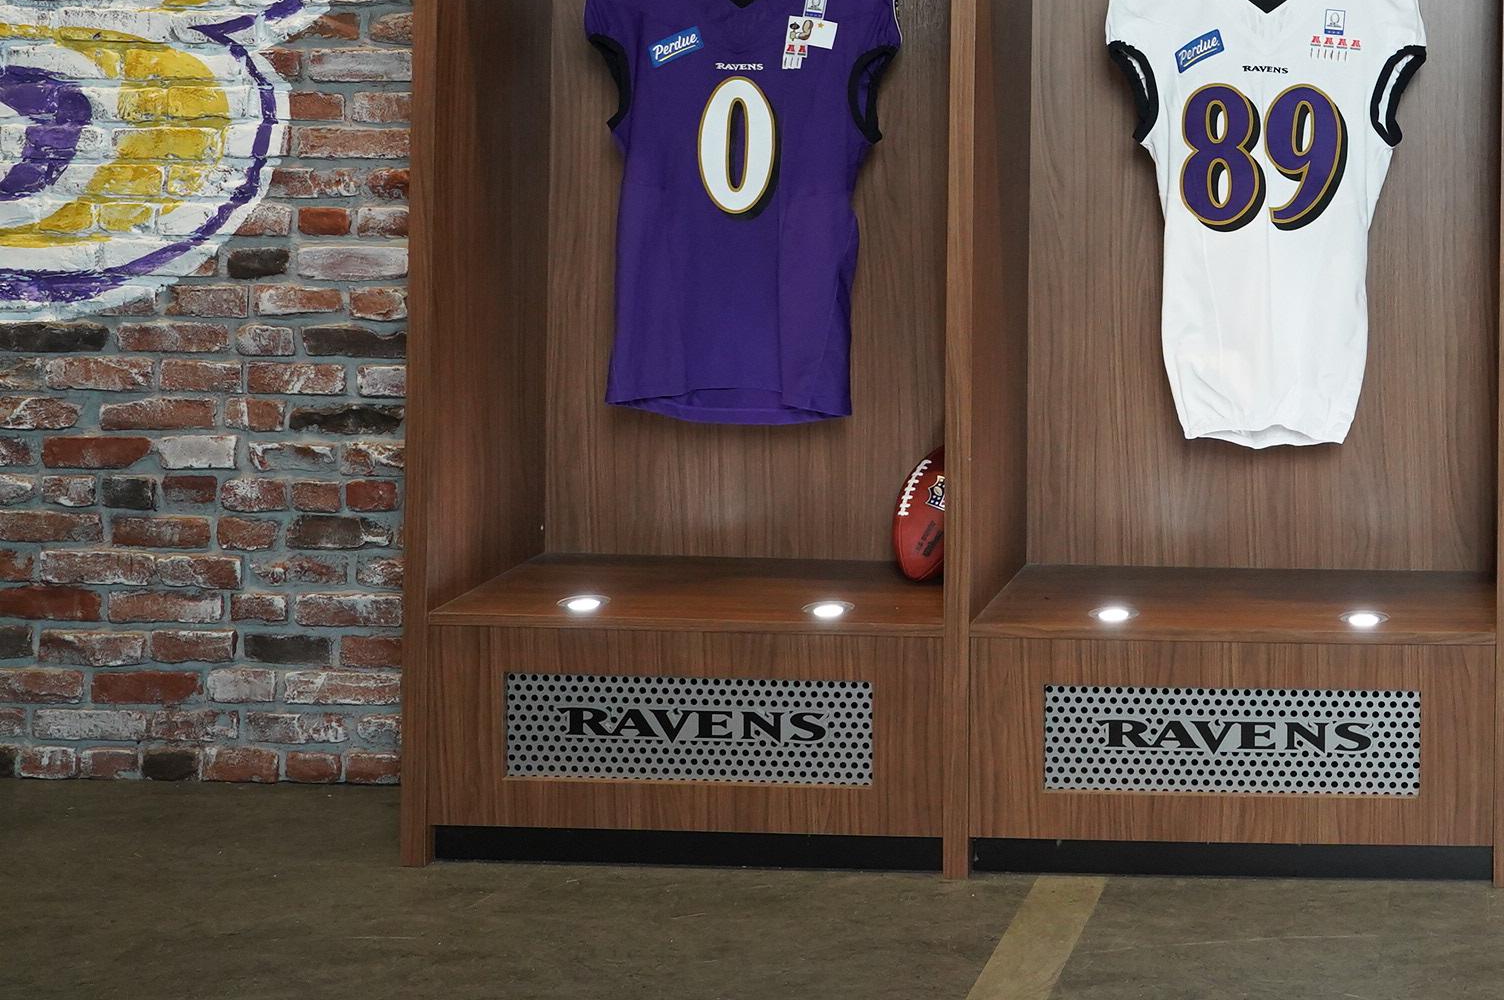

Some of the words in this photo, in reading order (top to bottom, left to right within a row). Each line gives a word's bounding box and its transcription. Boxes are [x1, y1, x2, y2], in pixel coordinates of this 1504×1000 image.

[652, 32, 699, 60] Perdue
[1179, 36, 1220, 66] Perdue
[715, 62, 764, 72] RAVENS
[1242, 65, 1289, 74] RAVENS
[698, 75, 777, 217] 0
[1180, 82, 1346, 229] 89
[556, 706, 827, 744] RAVENS
[1095, 719, 1373, 755] RAVENS
